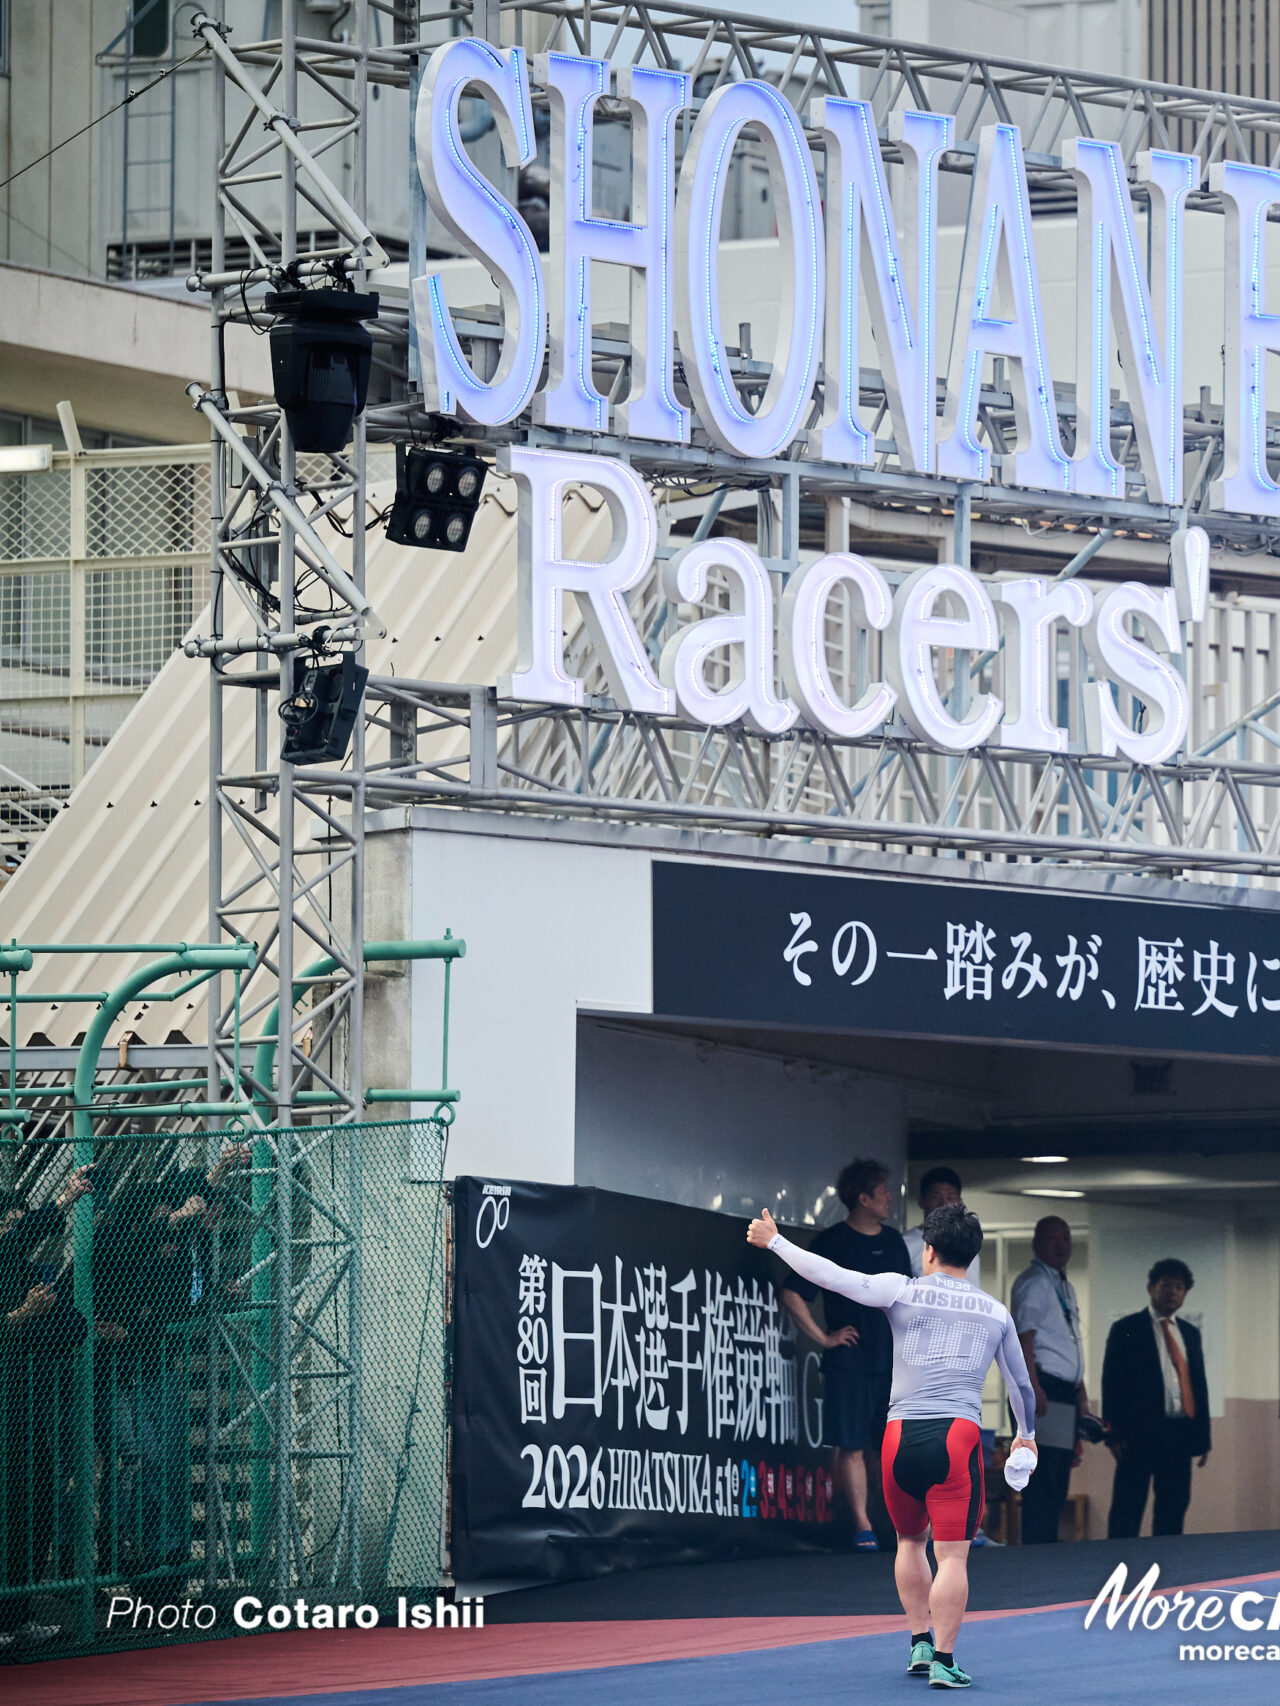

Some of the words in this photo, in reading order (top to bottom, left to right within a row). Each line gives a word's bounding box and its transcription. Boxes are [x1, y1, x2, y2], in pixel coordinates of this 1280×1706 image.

[412, 37, 1200, 506] SHONAN
[494, 444, 1210, 767] Racers'
[516, 1254, 549, 1425] 第80回
[911, 1288, 994, 1315] KOSHOW
[519, 1443, 606, 1510] 2026
[607, 1448, 714, 1514] HIRATSUKA
